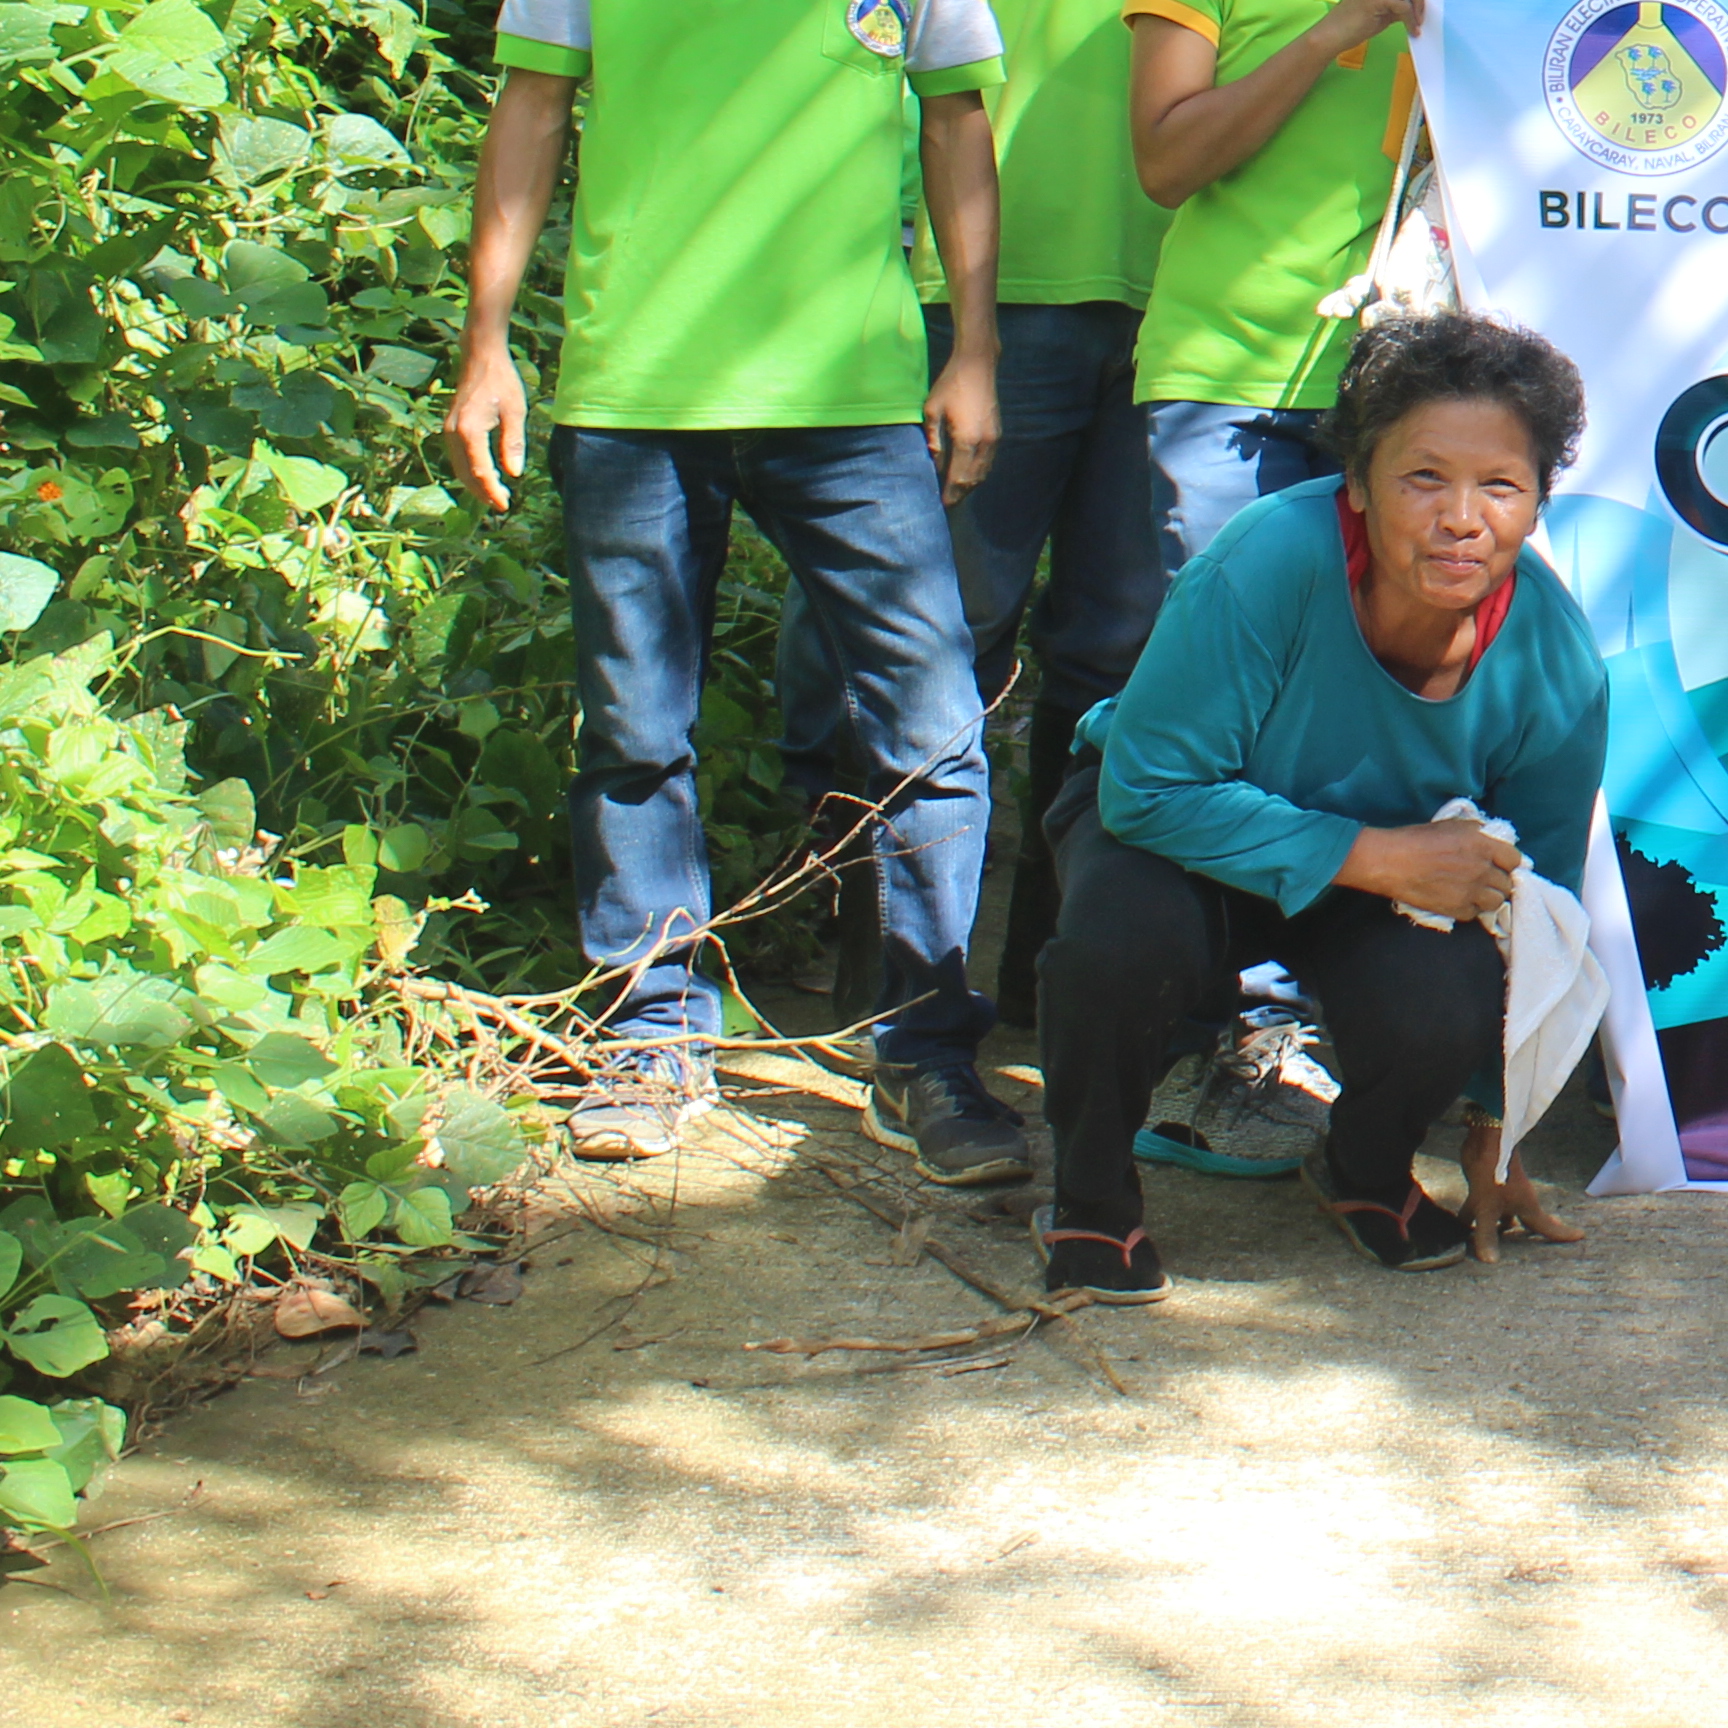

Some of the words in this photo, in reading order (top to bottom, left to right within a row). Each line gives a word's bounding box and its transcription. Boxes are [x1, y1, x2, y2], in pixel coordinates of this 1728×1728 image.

[1547, 32, 1574, 92] BILIRAN
[1594, 110, 1697, 144] BILECO
[1631, 113, 1663, 124] 1973
